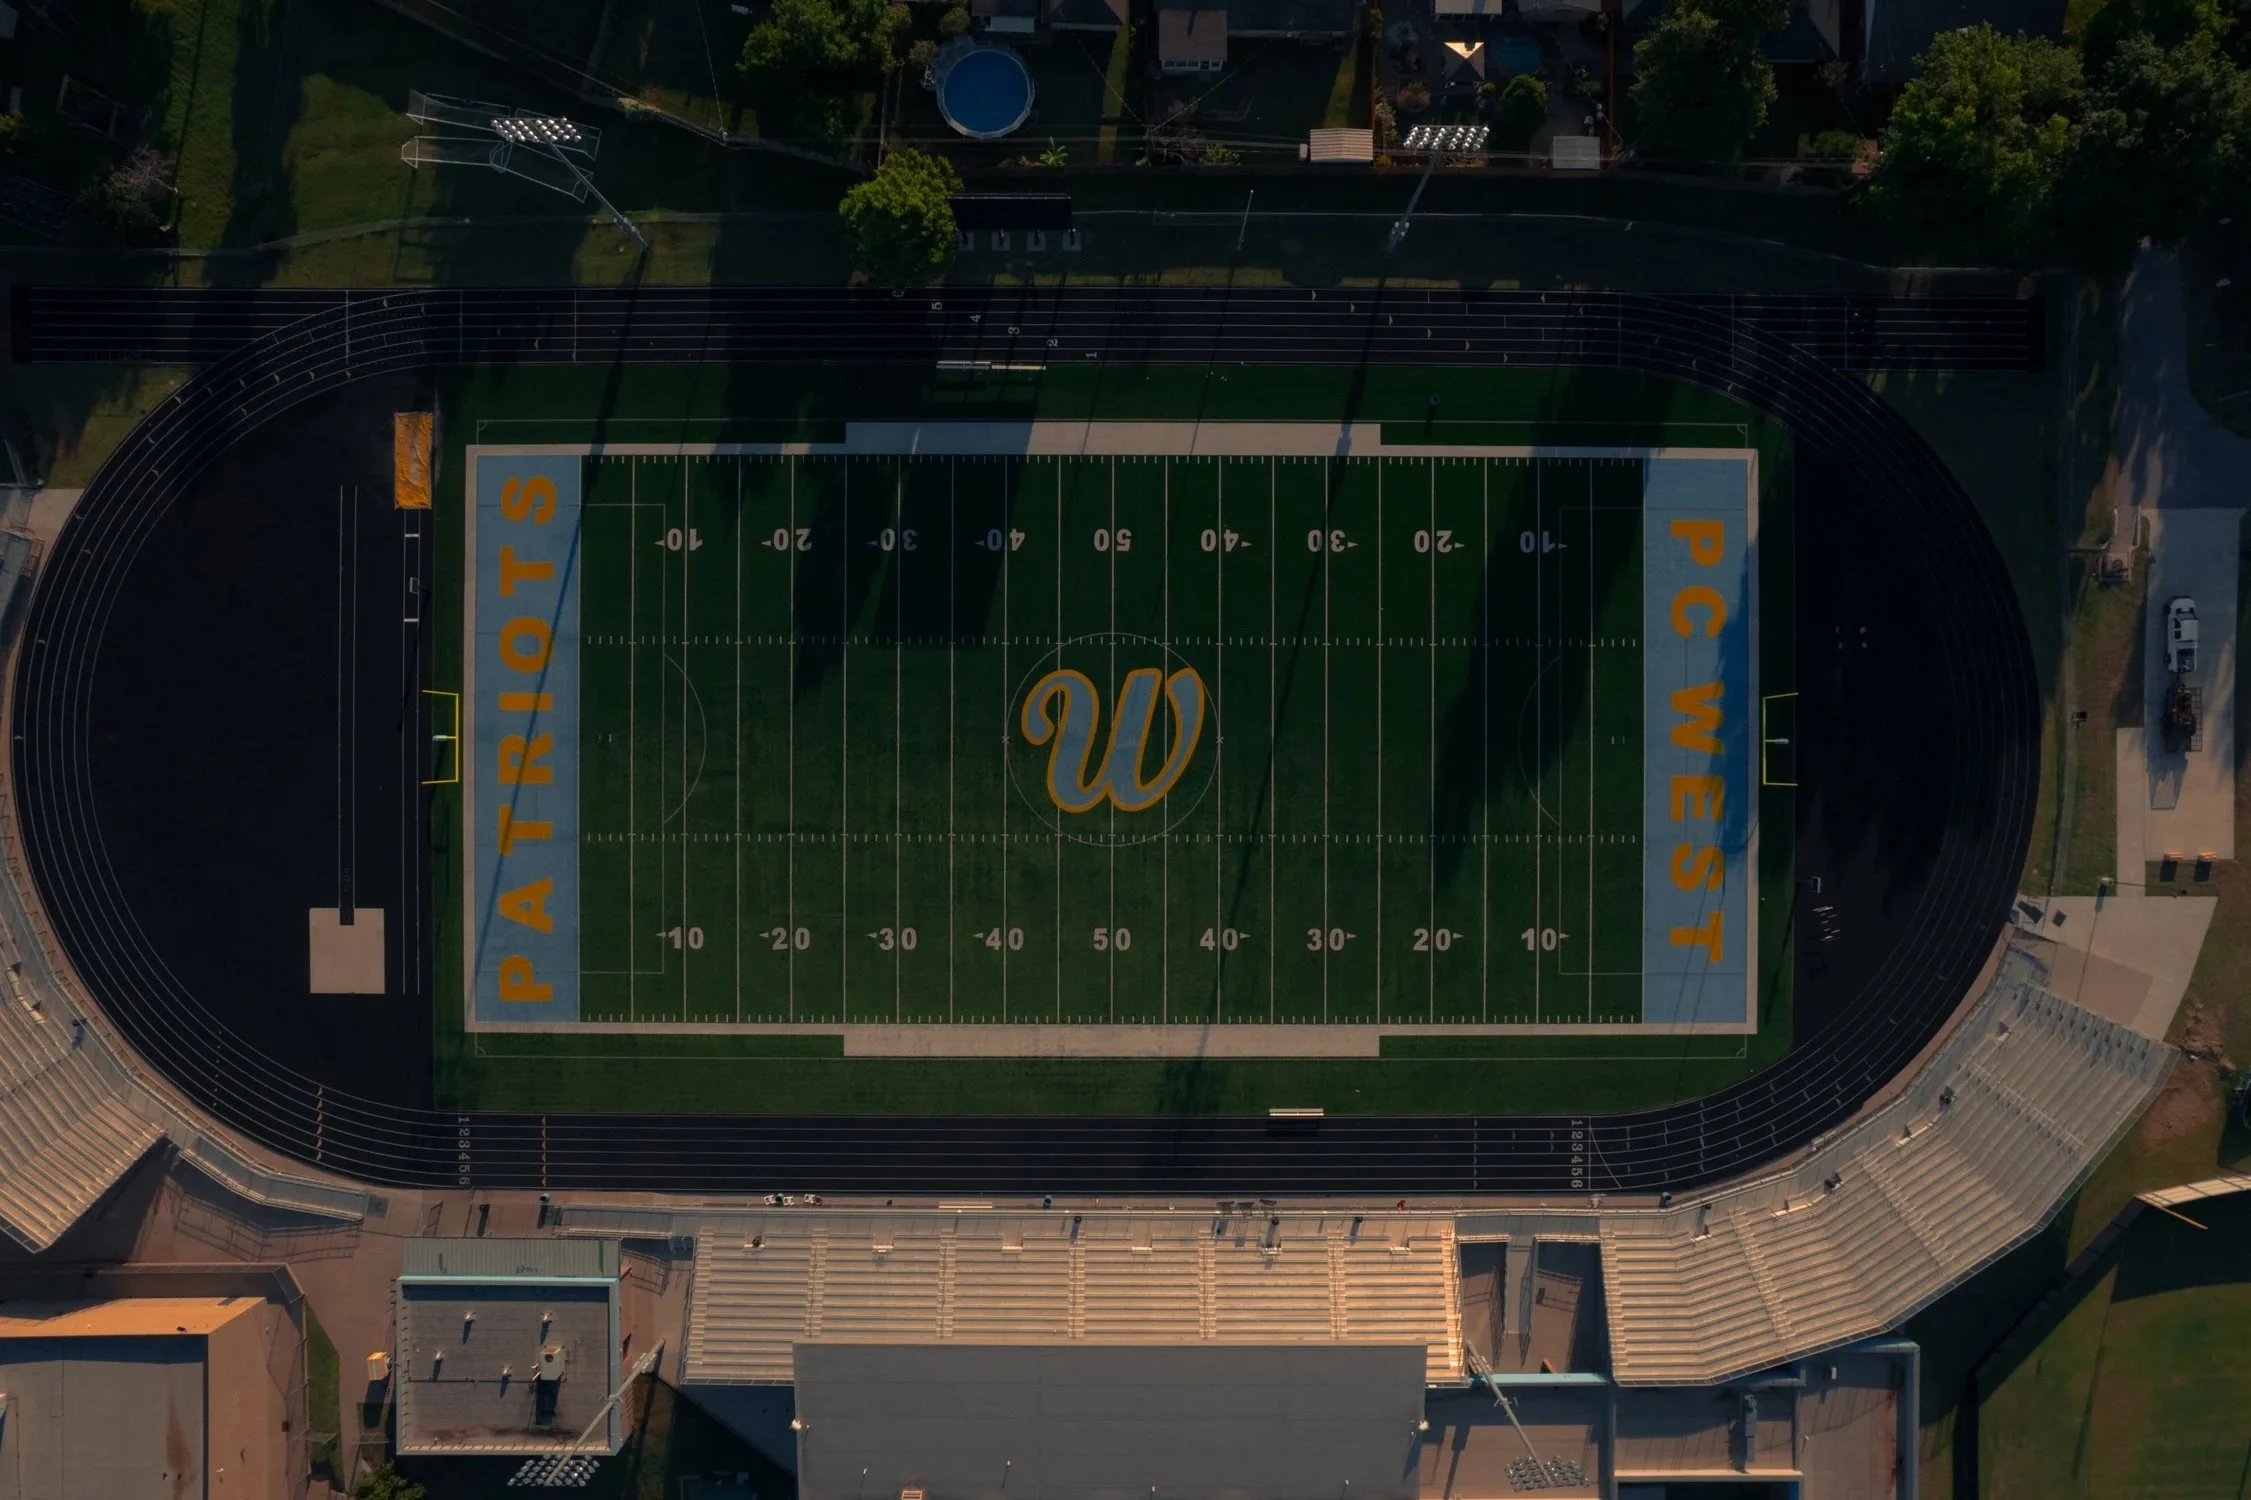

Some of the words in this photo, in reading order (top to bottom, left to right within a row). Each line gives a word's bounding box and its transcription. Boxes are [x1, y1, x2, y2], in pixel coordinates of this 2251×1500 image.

[931, 300, 943, 310] 5
[969, 312, 981, 322] 4
[1008, 326, 1020, 335] 3
[1047, 338, 1059, 347] 2
[1085, 351, 1097, 359] 1
[667, 528, 703, 551] 10
[773, 528, 812, 551] 20
[880, 529, 918, 551] 30
[987, 528, 1025, 551] 40
[1093, 528, 1132, 551] 50
[1200, 528, 1239, 552] 40
[1307, 529, 1346, 552] 30
[1413, 530, 1453, 553] 20
[1520, 530, 1556, 553] 10
[1670, 519, 1727, 639] PC
[498, 475, 557, 1003] PATRIOTS
[1020, 666, 1206, 815] W
[1670, 681, 1725, 963] WEST
[667, 927, 704, 950] 10
[772, 927, 810, 950] 20
[879, 928, 917, 950] 30
[985, 928, 1024, 950] 40
[1093, 928, 1131, 950] 50
[1199, 928, 1238, 951] 40
[1306, 928, 1345, 951] 30
[1412, 928, 1451, 951] 20
[1521, 928, 1557, 951] 10
